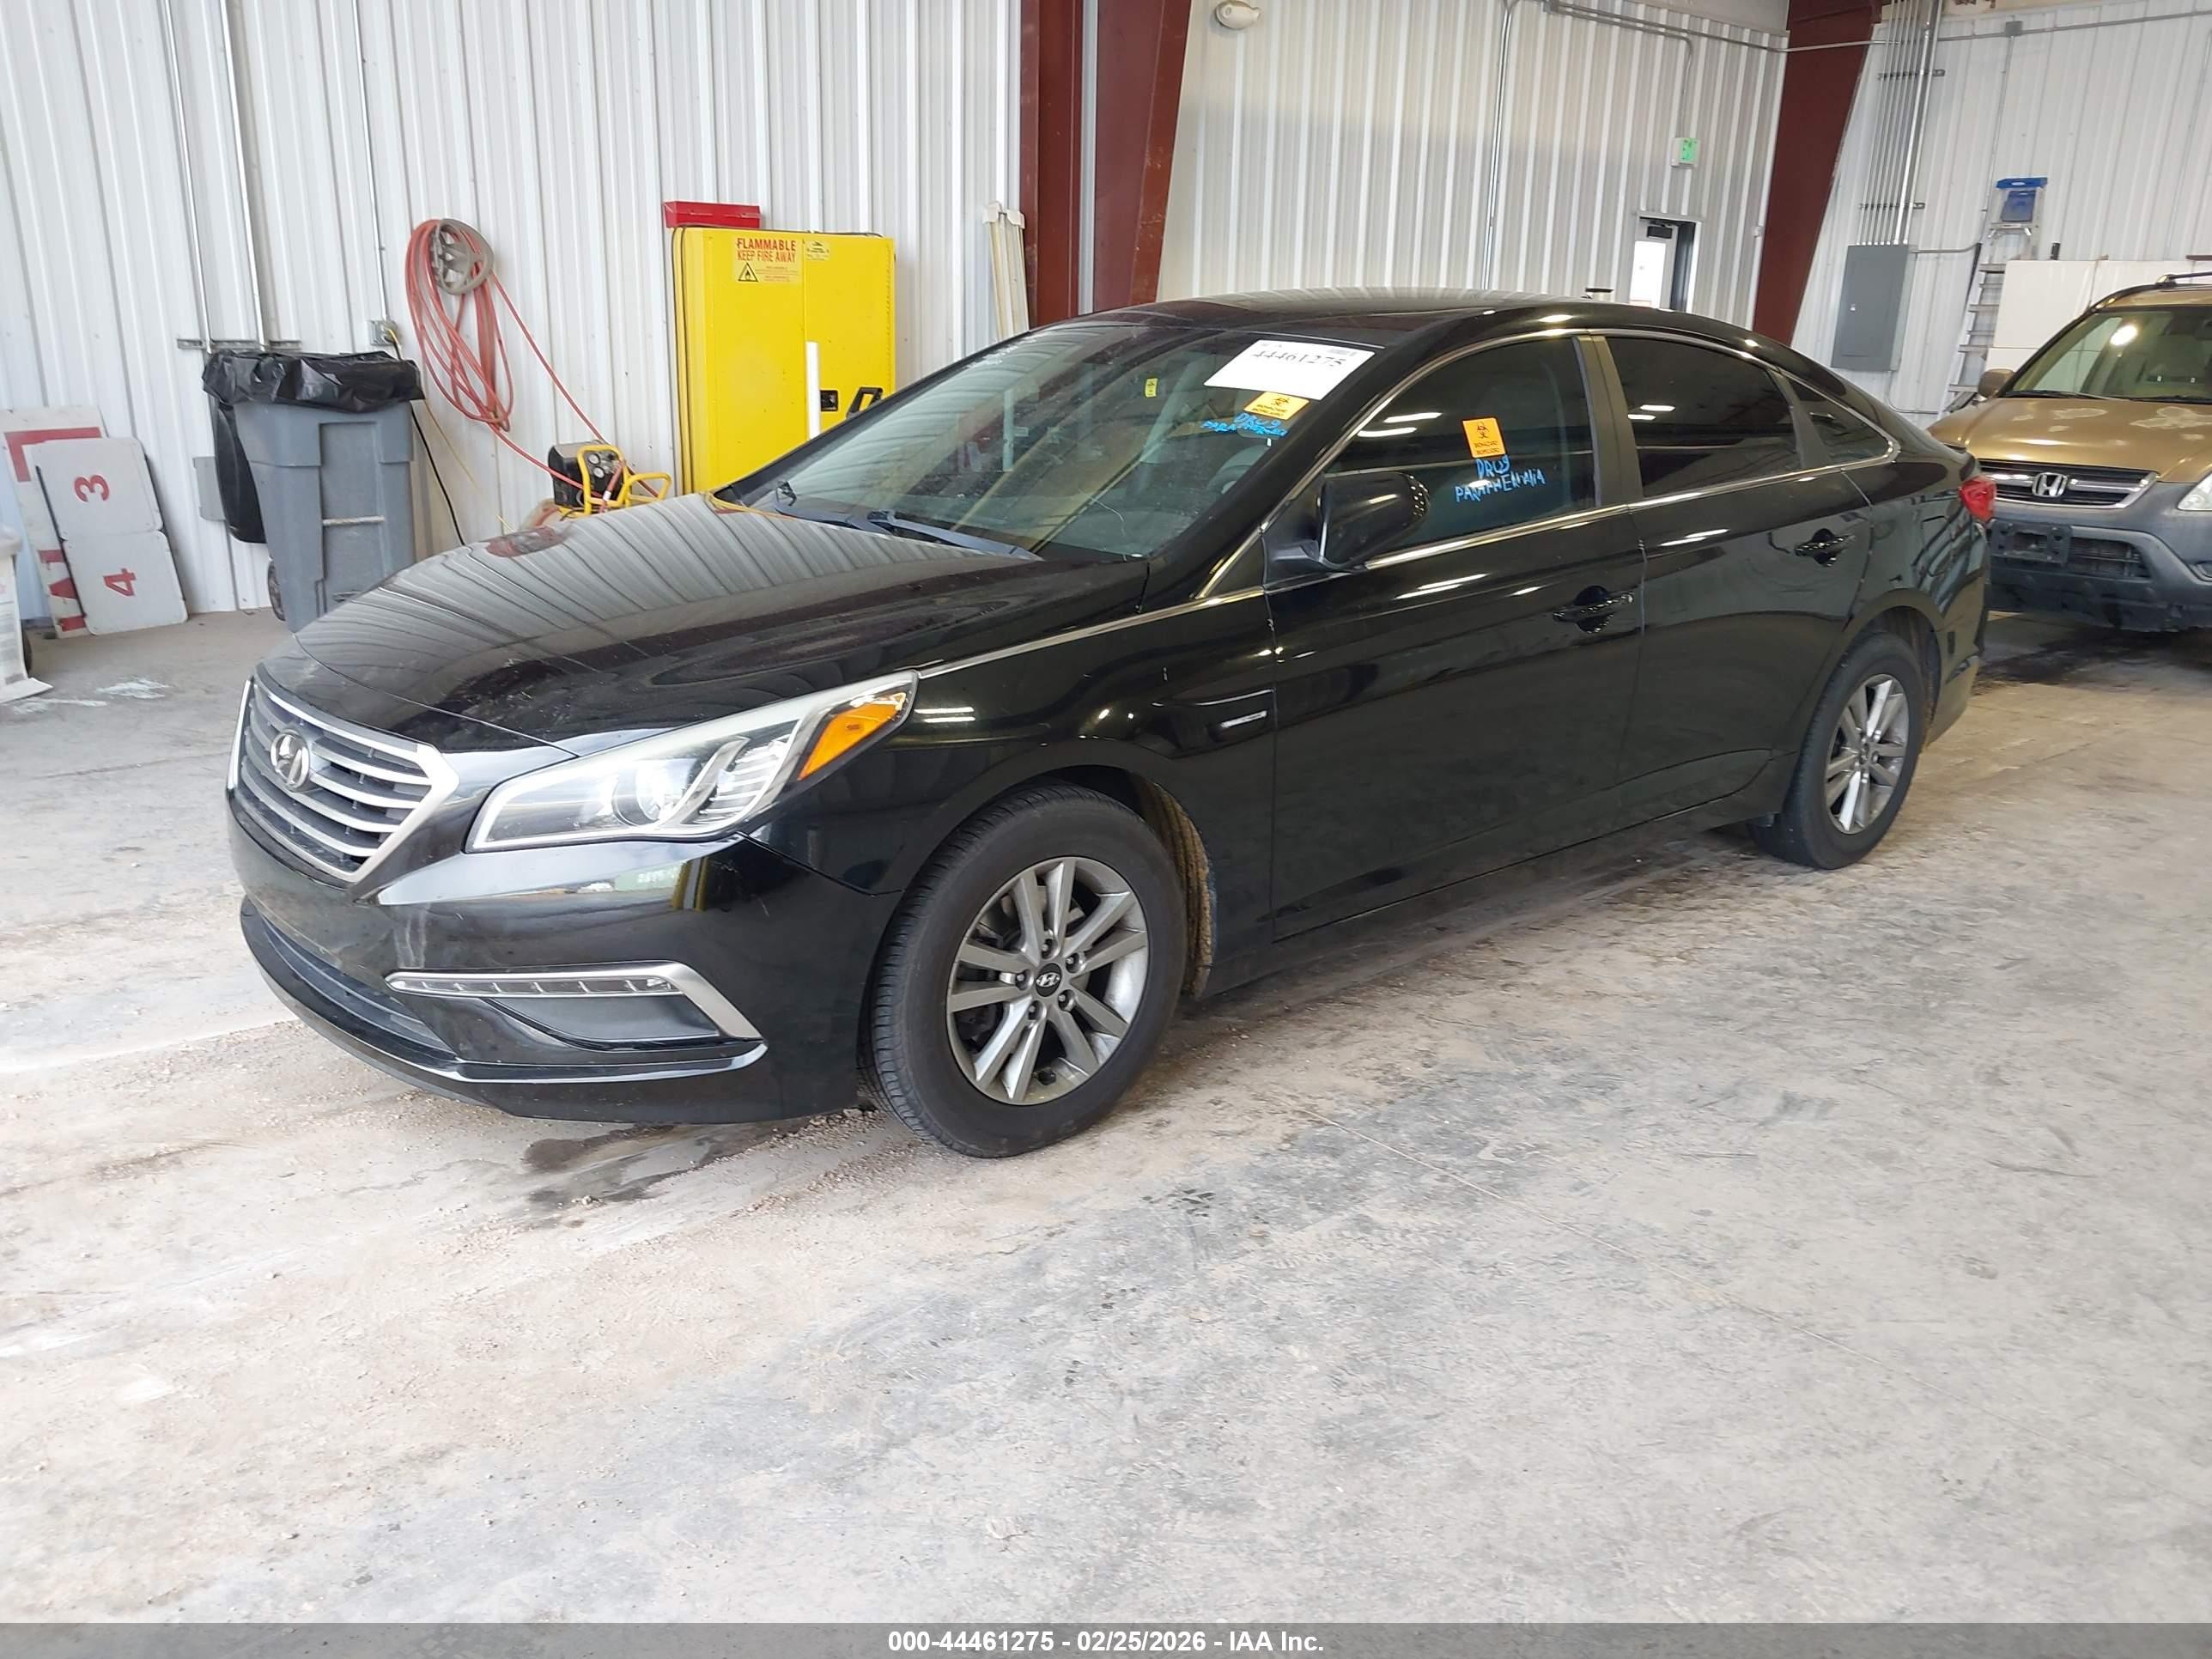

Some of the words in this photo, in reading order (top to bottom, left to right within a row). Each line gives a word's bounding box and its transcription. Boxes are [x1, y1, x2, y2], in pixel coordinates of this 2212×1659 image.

[737, 238, 797, 251] FLAMMABLE
[738, 250, 756, 261] KEEP
[757, 251, 774, 262] FIRE
[775, 252, 797, 263] AWAY
[74, 474, 110, 502] 3
[102, 568, 137, 597] 4
